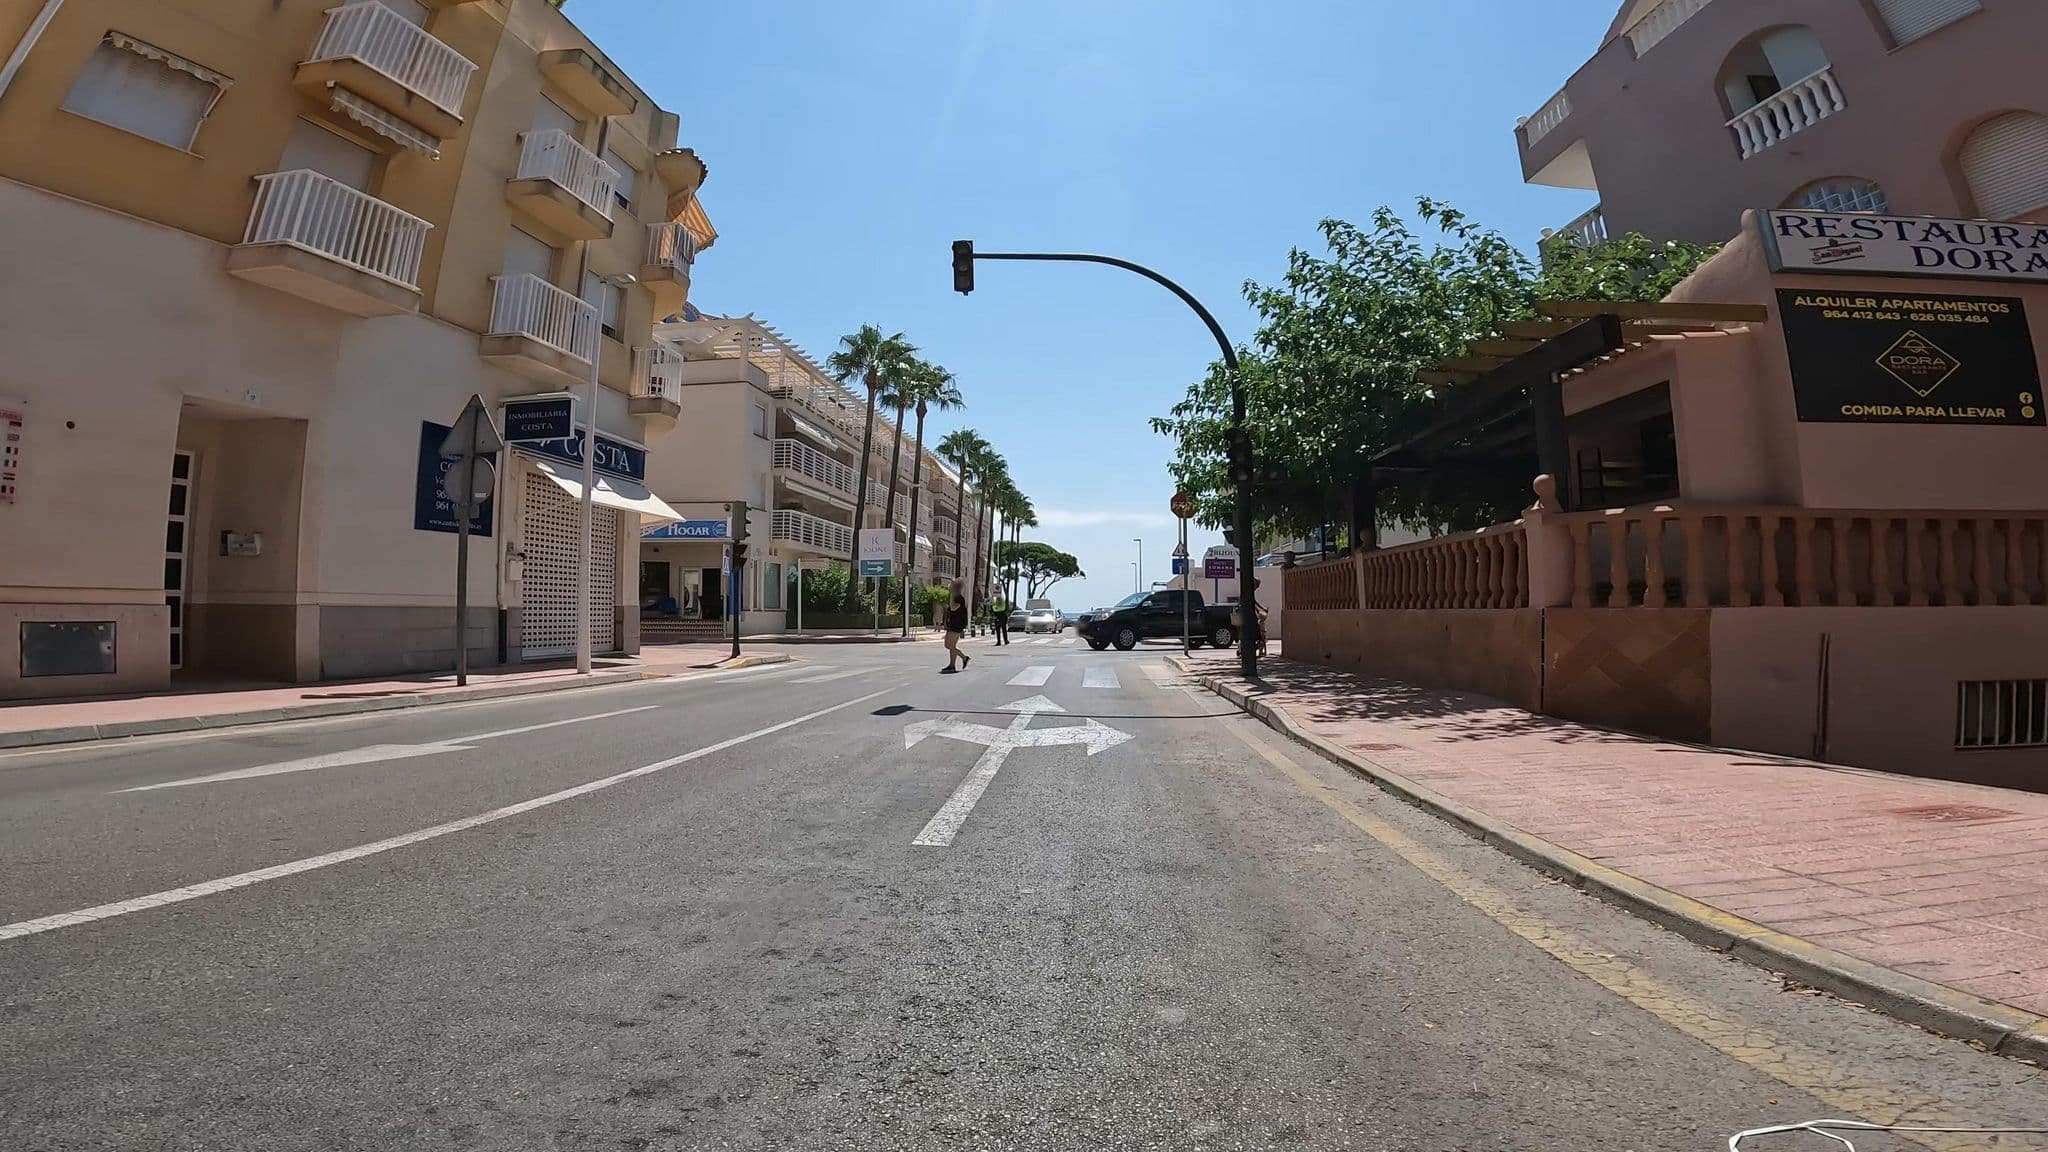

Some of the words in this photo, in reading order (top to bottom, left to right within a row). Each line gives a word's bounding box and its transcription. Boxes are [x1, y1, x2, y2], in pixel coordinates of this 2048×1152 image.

[1910, 246, 2048, 273] DORA
[1795, 296, 1878, 308] ALQUILER
[1881, 299, 2010, 314] APARTAMENTOS
[1822, 309, 1850, 318] 964
[1852, 311, 1874, 319] 412
[1876, 312, 1901, 320] 643
[1889, 355, 1946, 365] DORA
[508, 410, 568, 420] INMOBILIARIA
[1841, 405, 1901, 416] COMIDA
[1906, 406, 1946, 417] PARA
[1949, 407, 2006, 418] LLEVAR
[521, 422, 554, 432] COSTA
[668, 523, 710, 536] HOGAR
